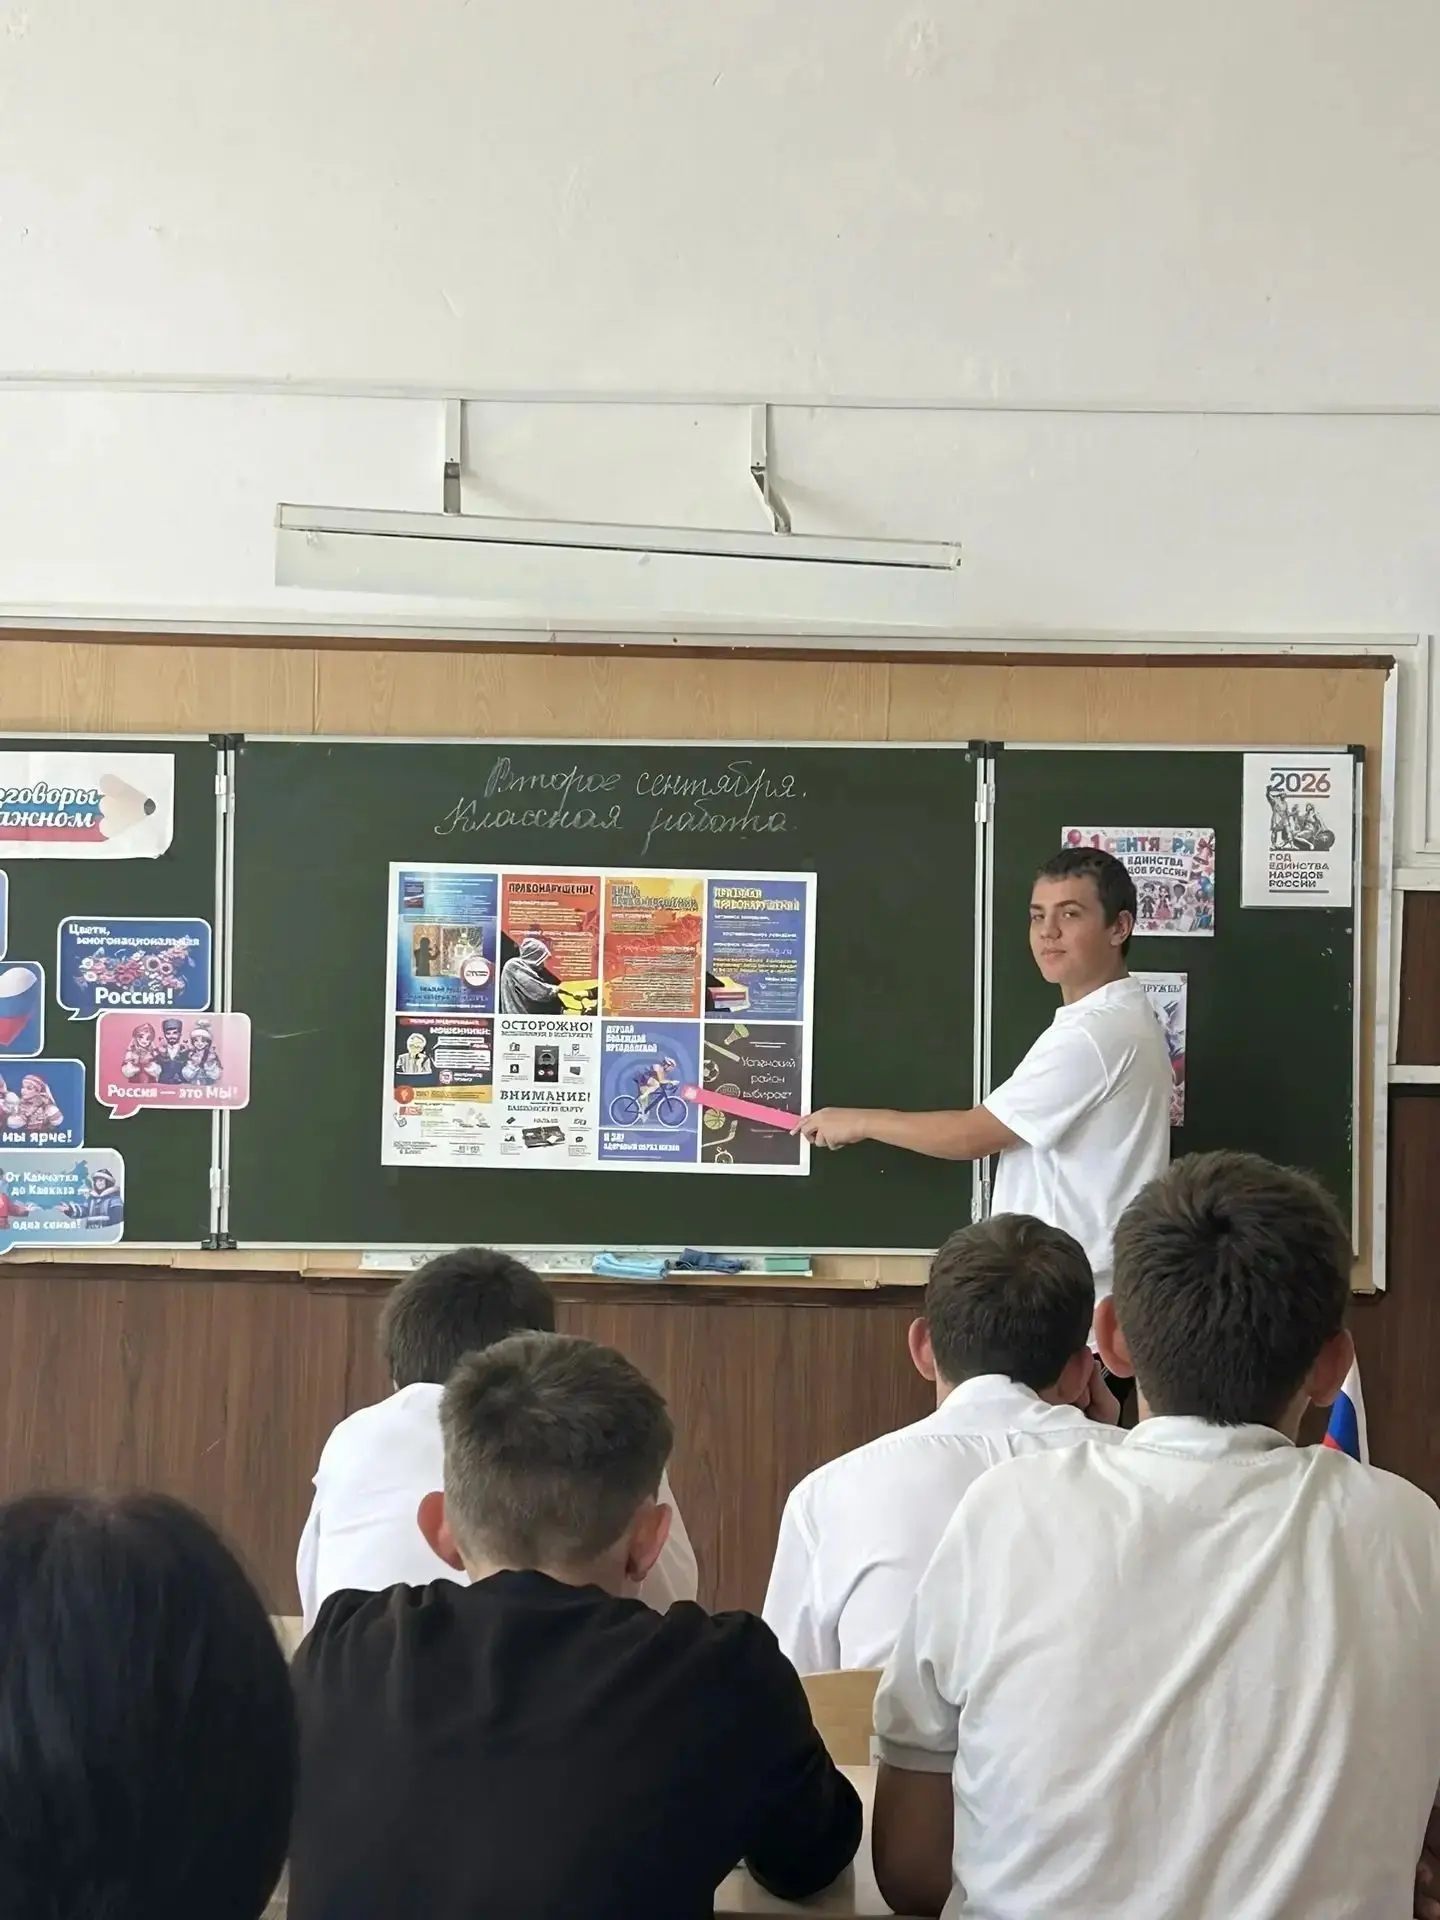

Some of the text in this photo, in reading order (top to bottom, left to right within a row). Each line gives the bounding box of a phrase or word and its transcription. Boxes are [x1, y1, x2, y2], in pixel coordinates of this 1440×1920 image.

[484, 756, 621, 815] Второе
[1269, 772, 1331, 793] 2026
[434, 797, 624, 835] Классная
[1269, 853, 1292, 862] ГОД
[1149, 867, 1188, 877] РОССИИ
[1269, 862, 1330, 870] ЕДИНСТВА
[1269, 871, 1324, 879] НАРОДОВ
[1269, 880, 1317, 888] РОССИИ
[68, 924, 111, 936] Цвети,
[76, 937, 200, 947] многонациональная
[95, 986, 173, 1005] Россия!
[501, 1020, 593, 1032] ОСТОРОЖНО!
[750, 1073, 785, 1085] район
[107, 1085, 157, 1098] Россия
[179, 1088, 201, 1099] это
[500, 1090, 591, 1102] ВНИМАНИЕ!
[2, 1129, 73, 1146] мы ярче!
[5, 1171, 21, 1183] От
[11, 1187, 26, 1196] до
[28, 1185, 75, 1195] Кавказа
[12, 1221, 40, 1230] одна
